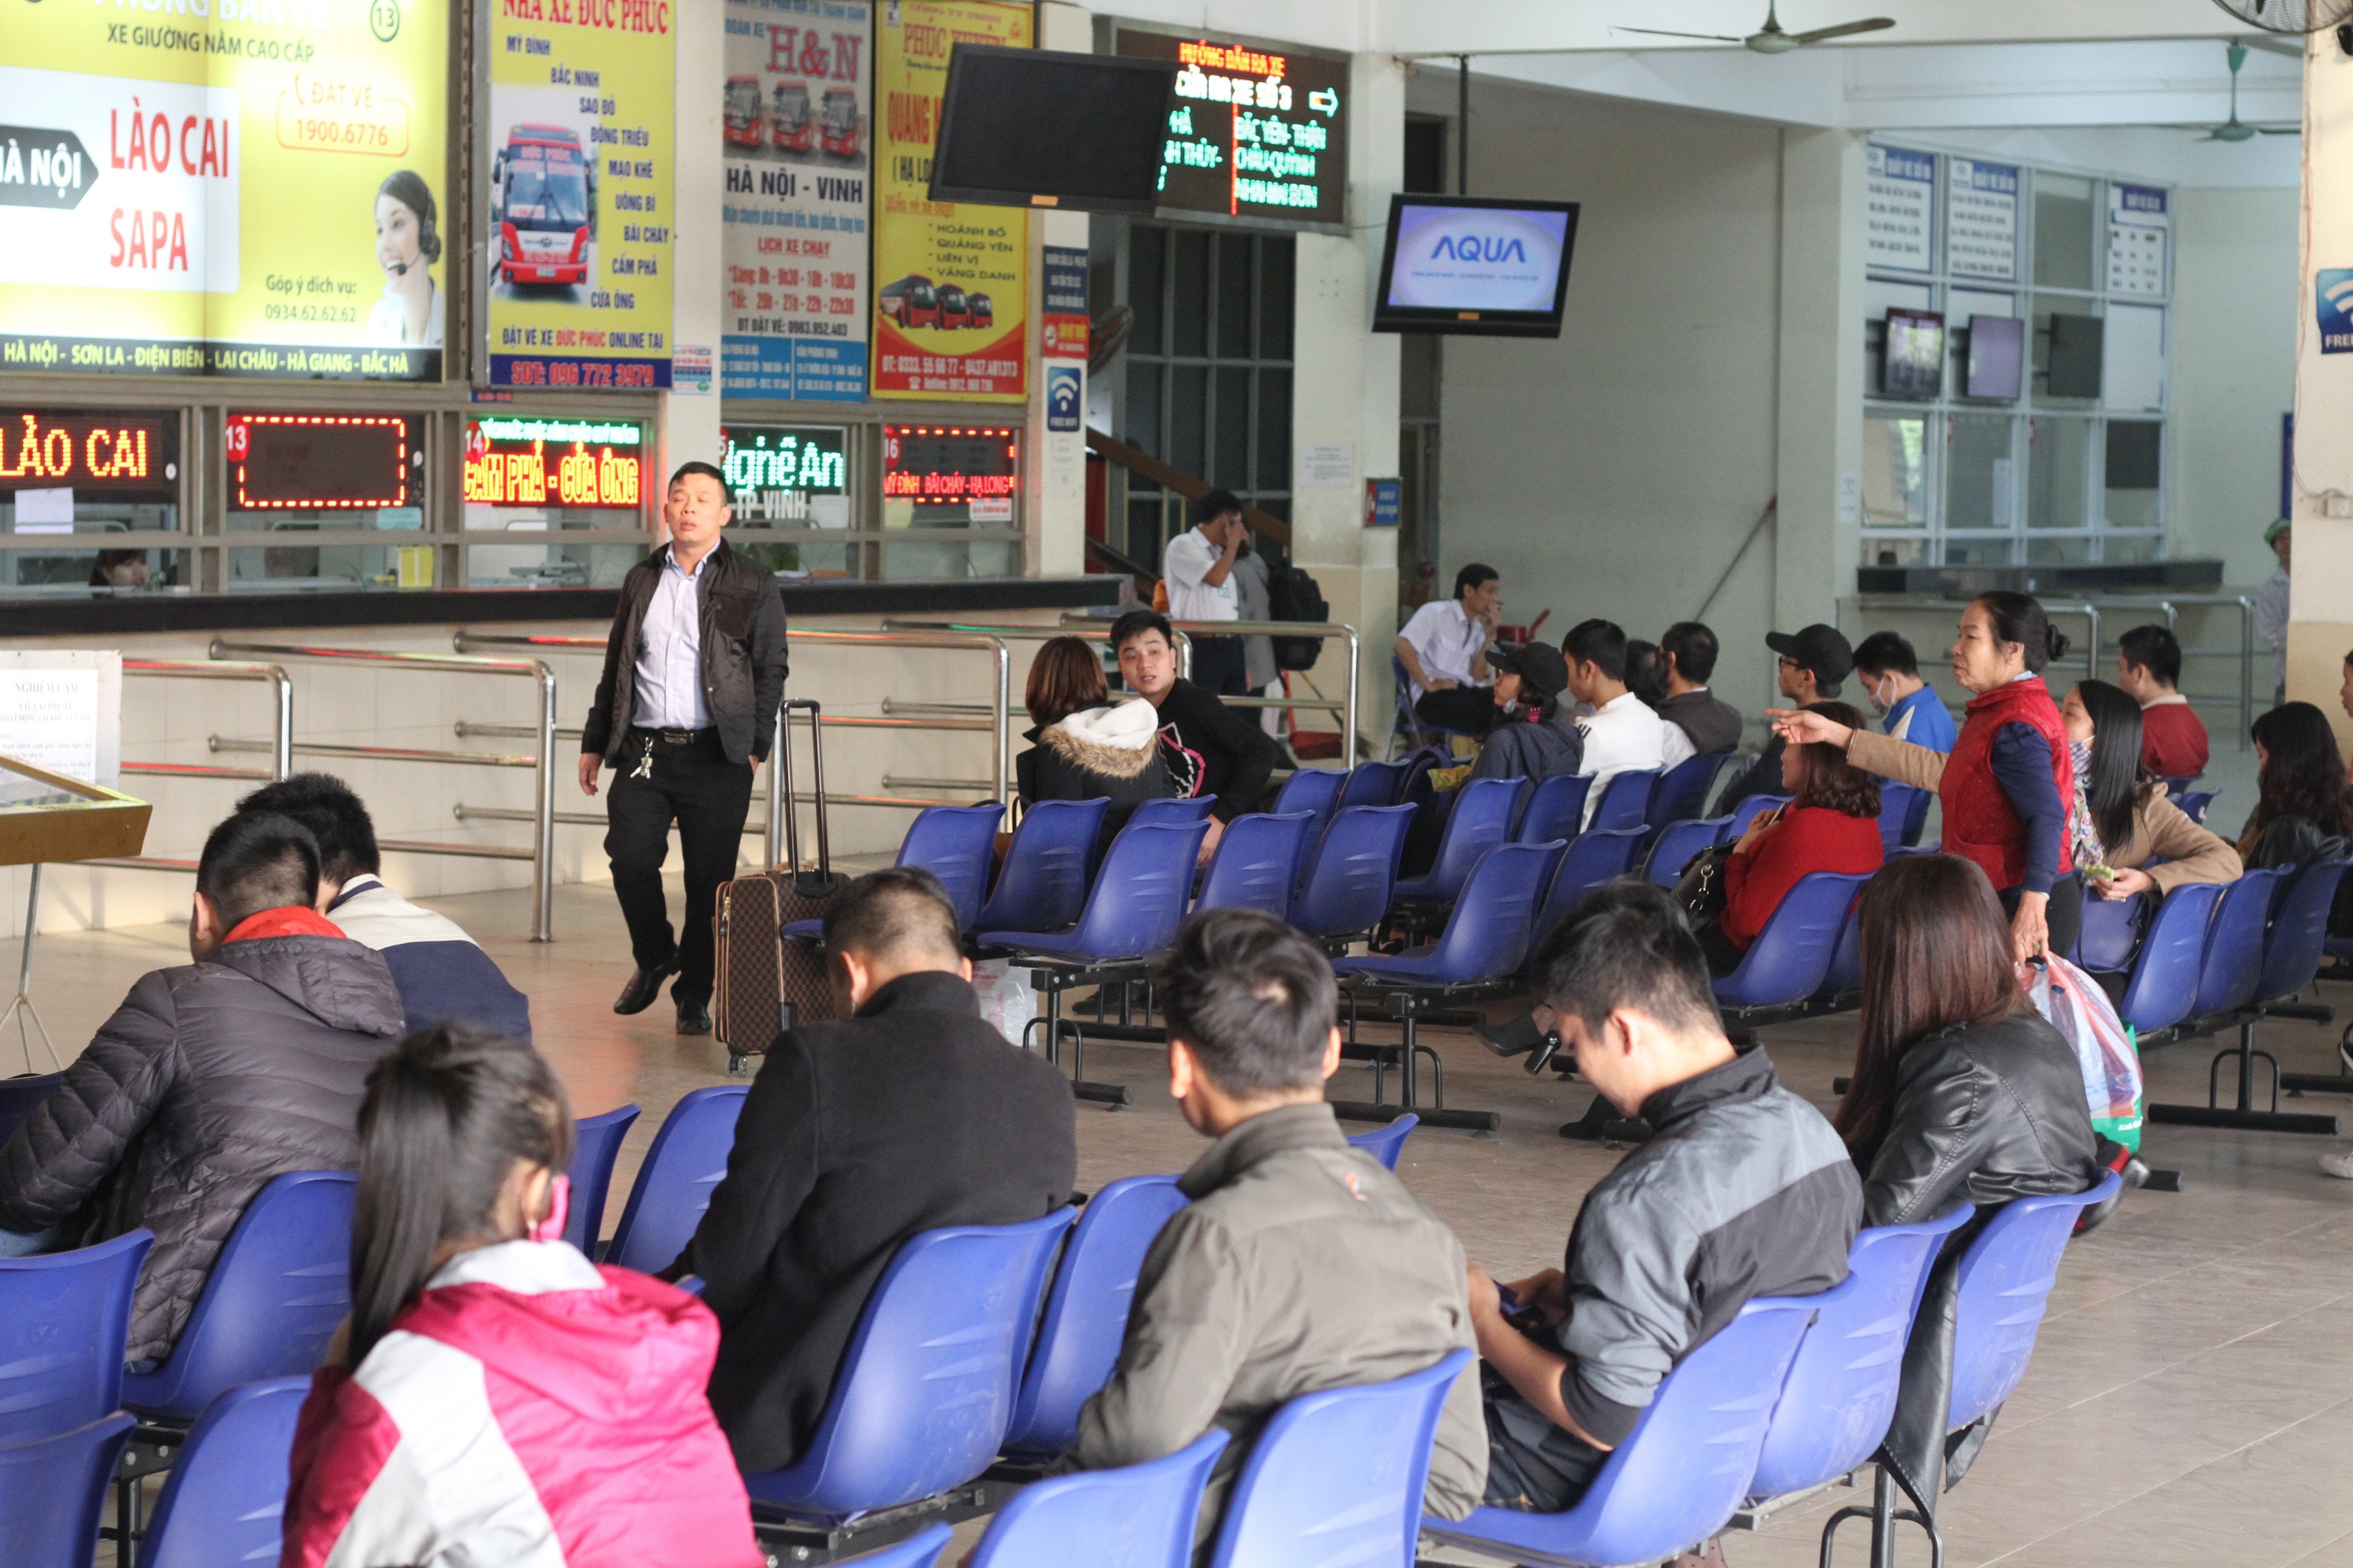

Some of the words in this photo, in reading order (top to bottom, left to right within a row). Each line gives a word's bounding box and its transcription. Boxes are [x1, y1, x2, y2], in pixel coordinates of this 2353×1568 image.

[377, 8, 395, 27] 13
[108, 23, 128, 44] XE
[132, 25, 200, 52] GIƯỜNG
[246, 39, 280, 60] CAO
[284, 37, 314, 62] CẤP
[766, 24, 863, 83] H&N
[574, 69, 600, 87] NINH
[579, 96, 599, 115] SAO
[1279, 84, 1293, 111] 3
[111, 95, 171, 174] LÀO
[180, 115, 228, 178] CAI
[296, 118, 388, 146] 1900.6776
[30, 142, 82, 199] NỘI
[726, 163, 754, 193] HÀ
[761, 166, 796, 202] NỘI
[817, 176, 863, 204] VINH
[110, 208, 188, 272] SAPA
[990, 242, 1014, 252] YÊN
[1429, 235, 1527, 264] AQUA
[265, 274, 293, 296] Góp
[296, 275, 303, 296] ý
[306, 276, 334, 297] dịch
[979, 271, 1016, 281] DANH
[265, 303, 356, 323] 0934.62.62.62
[614, 289, 635, 310] ÔNG
[541, 328, 554, 346] XE
[609, 331, 645, 349] ONLINE
[647, 332, 664, 353] TẠI
[2325, 333, 2353, 349] FRE
[4, 339, 27, 363] HÀ
[29, 339, 58, 369] NỘI
[71, 343, 104, 366] SƠN
[106, 346, 125, 366] LA
[134, 344, 170, 372] ĐIỆN
[172, 345, 205, 369] BIÊN
[214, 349, 238, 369] LAI
[238, 347, 279, 371] CHÂU
[287, 349, 308, 371] HÀ
[309, 353, 353, 373] GIANG
[548, 362, 579, 386] 096
[581, 364, 613, 387] 772
[614, 364, 655, 387] 3979
[0, 415, 72, 477] LÀO
[87, 429, 147, 477] CAI
[225, 424, 247, 451] 13
[885, 438, 899, 459] 16
[600, 446, 639, 504] ÔNG
[799, 442, 844, 487] An
[735, 491, 758, 520] TP
[763, 489, 807, 520] VINH
